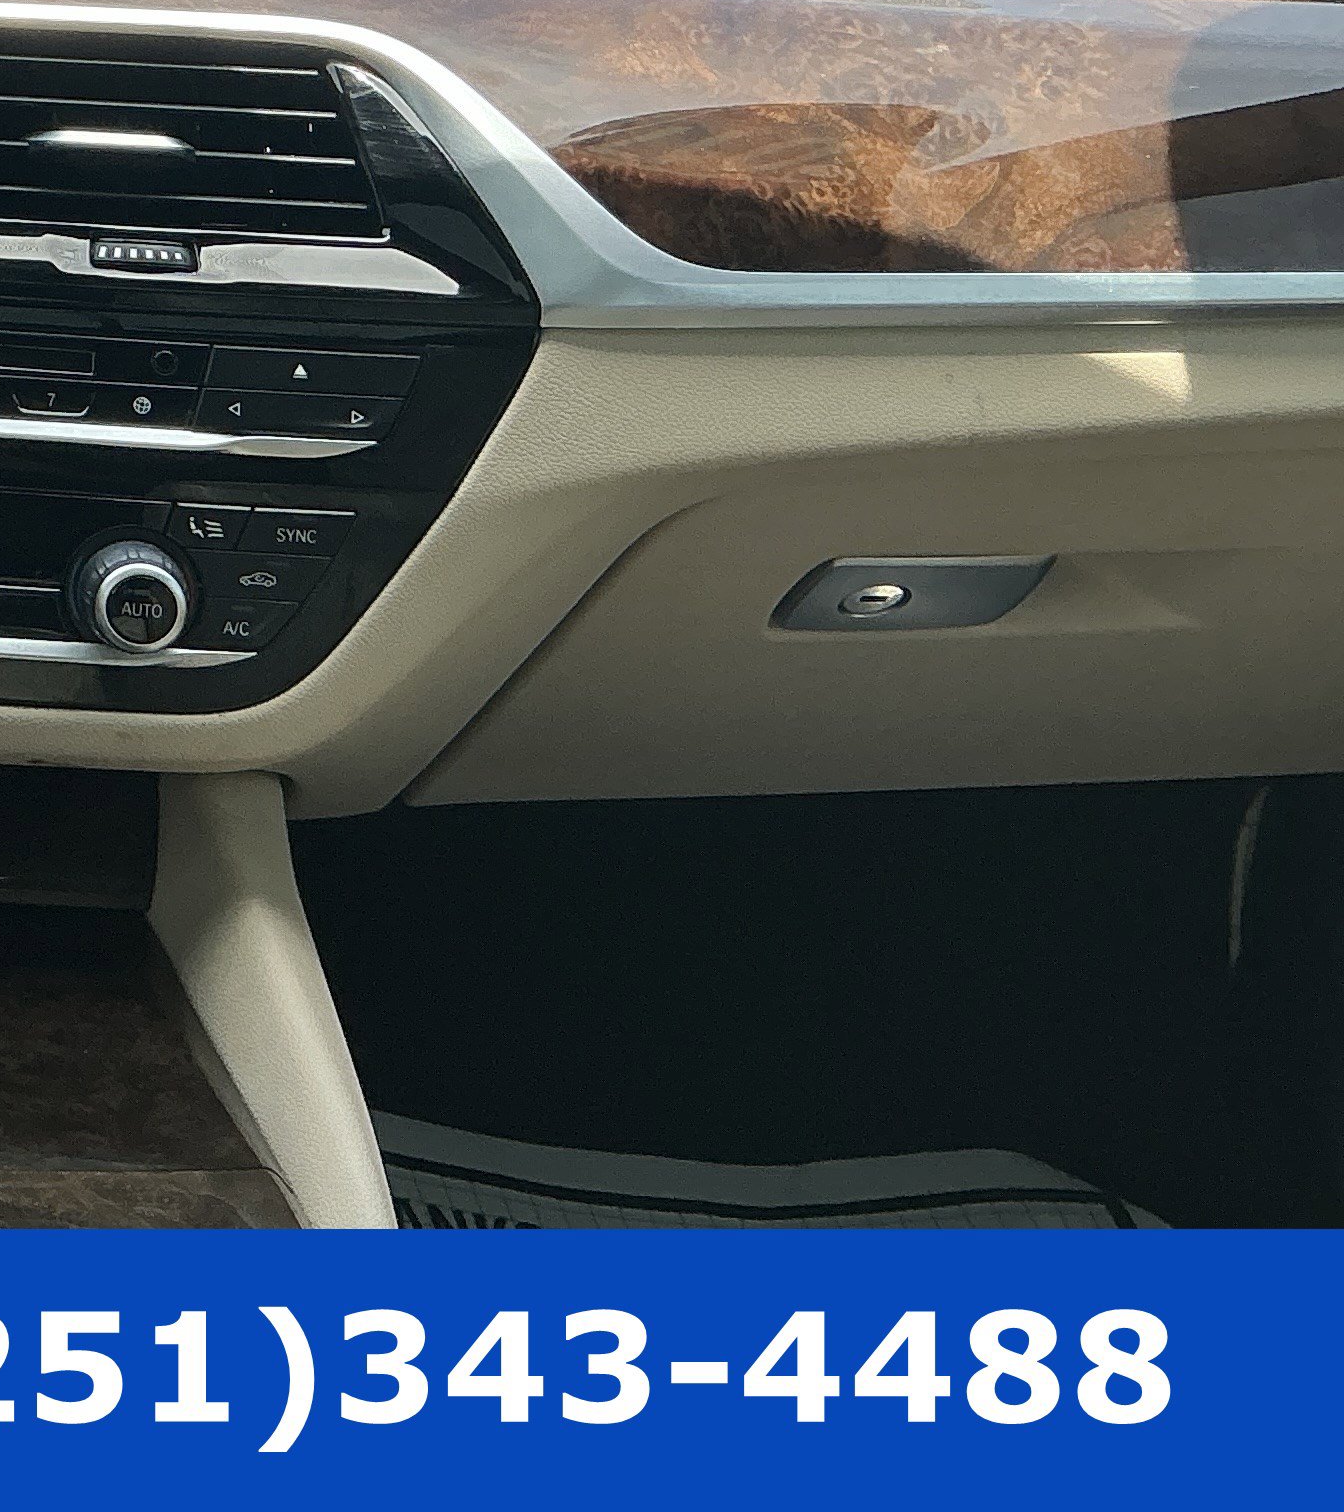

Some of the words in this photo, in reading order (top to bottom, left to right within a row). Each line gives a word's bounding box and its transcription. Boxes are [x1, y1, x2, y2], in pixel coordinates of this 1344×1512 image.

[45, 392, 56, 408] 7
[276, 527, 317, 546] SYNC
[121, 600, 163, 620] AUTO
[223, 619, 250, 638] A/C
